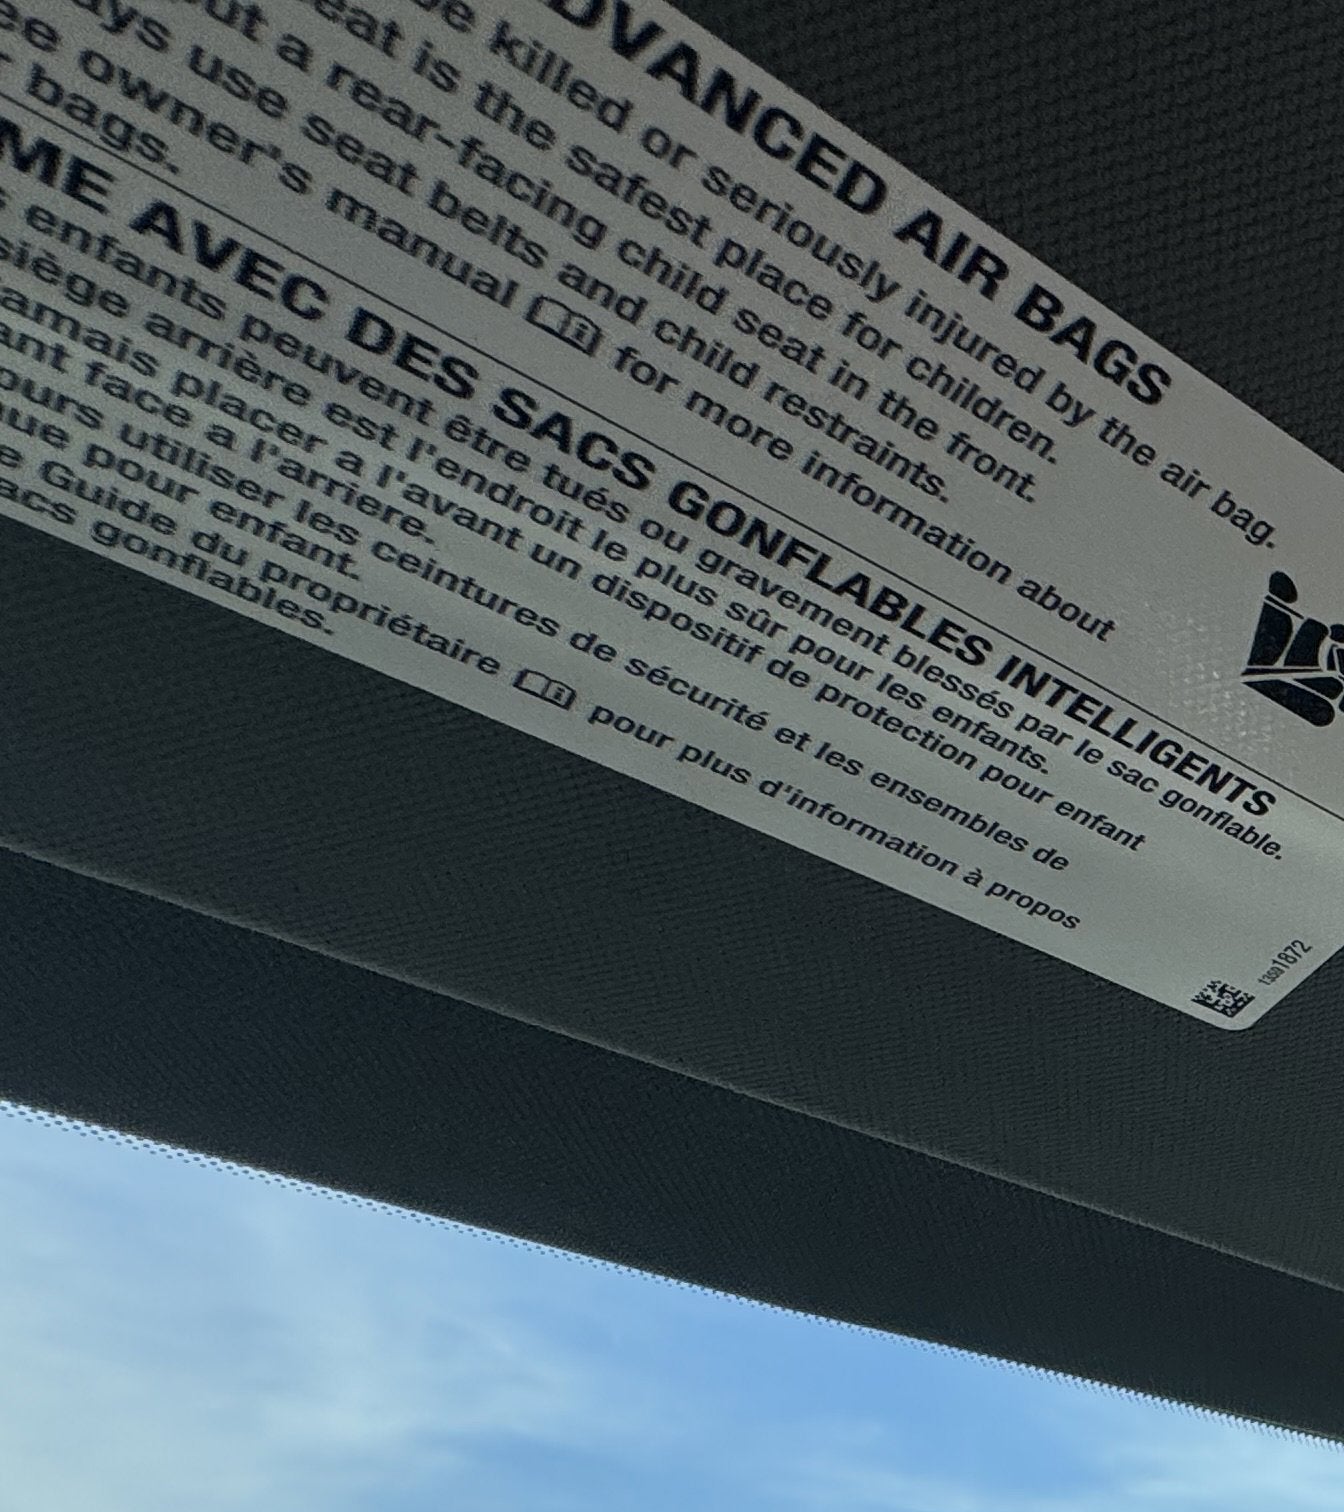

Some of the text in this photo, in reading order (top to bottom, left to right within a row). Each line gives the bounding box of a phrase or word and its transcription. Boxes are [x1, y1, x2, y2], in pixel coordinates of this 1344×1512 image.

[25, 61, 180, 175] bags.
[77, 48, 313, 195] owner's
[324, 187, 520, 309] manual
[613, 345, 680, 394] for
[683, 389, 794, 461] more
[800, 449, 1013, 585] information
[1015, 578, 1116, 642] about
[187, 43, 289, 121] use
[299, 112, 420, 197] seat
[426, 179, 549, 269] belts
[556, 262, 649, 326] and
[651, 318, 761, 389] child
[761, 380, 949, 503] restraints.
[325, 61, 608, 251] rear-facing
[615, 237, 730, 316] child
[730, 307, 826, 375] seat
[827, 358, 870, 401] in
[876, 388, 940, 441] the
[945, 430, 1035, 503] front.
[411, 38, 461, 94] is
[472, 79, 557, 151] the
[564, 144, 713, 249] safest
[711, 237, 834, 321] place
[840, 310, 903, 360] for
[905, 355, 1057, 465] children.
[487, 18, 634, 134] killed
[639, 125, 698, 169] or
[700, 164, 902, 304] seriously
[903, 288, 1046, 394] injured
[1044, 380, 1097, 428] by
[1097, 415, 1157, 467] the
[1159, 461, 1212, 498] air
[1209, 489, 1275, 549] bag.
[891, 207, 1010, 302] AIR
[1012, 282, 1172, 406] BAGS
[23, 203, 1282, 860] enfants peuvent être tués ou gravement blessés par le sac gonflable.
[80, 442, 200, 504] pour
[207, 499, 360, 581] enfant.
[83, 360, 193, 429] face
[90, 519, 334, 636] gonflables.
[127, 198, 330, 322] AVEC
[343, 305, 480, 400] DES
[489, 386, 657, 491] SACS
[666, 479, 993, 667] GONFLABLES
[993, 653, 1276, 816] INTELLIGENTS
[142, 311, 313, 408] arrière
[321, 401, 400, 451] est
[405, 436, 586, 542] l'endroit
[589, 528, 628, 562] le
[632, 555, 719, 607] plus
[723, 600, 788, 638] sûr
[786, 633, 875, 681] pour
[875, 672, 927, 710] les
[931, 705, 1048, 775] enfants.
[169, 369, 328, 453] placer
[375, 463, 524, 552] l'avant
[528, 542, 583, 580] un
[590, 573, 766, 664] dispositif
[765, 658, 811, 688] de
[813, 682, 978, 770] protection
[977, 763, 1055, 804] pour
[1053, 800, 1146, 851] enfant
[37, 459, 178, 536] Guide
[189, 530, 249, 567] du
[257, 559, 501, 675] propriétaire
[586, 704, 676, 748] pour
[674, 743, 752, 785] plus
[757, 779, 959, 876] d'information
[961, 866, 984, 888] à
[983, 881, 1081, 929] propos
[117, 422, 286, 509] utiliser
[292, 498, 361, 546] les
[369, 540, 561, 637] ceintures
[568, 631, 617, 663] de
[623, 657, 770, 731] sécurité
[773, 726, 812, 752] et
[812, 741, 864, 776] les
[868, 771, 1029, 852] ensembles
[1031, 847, 1069, 871] de
